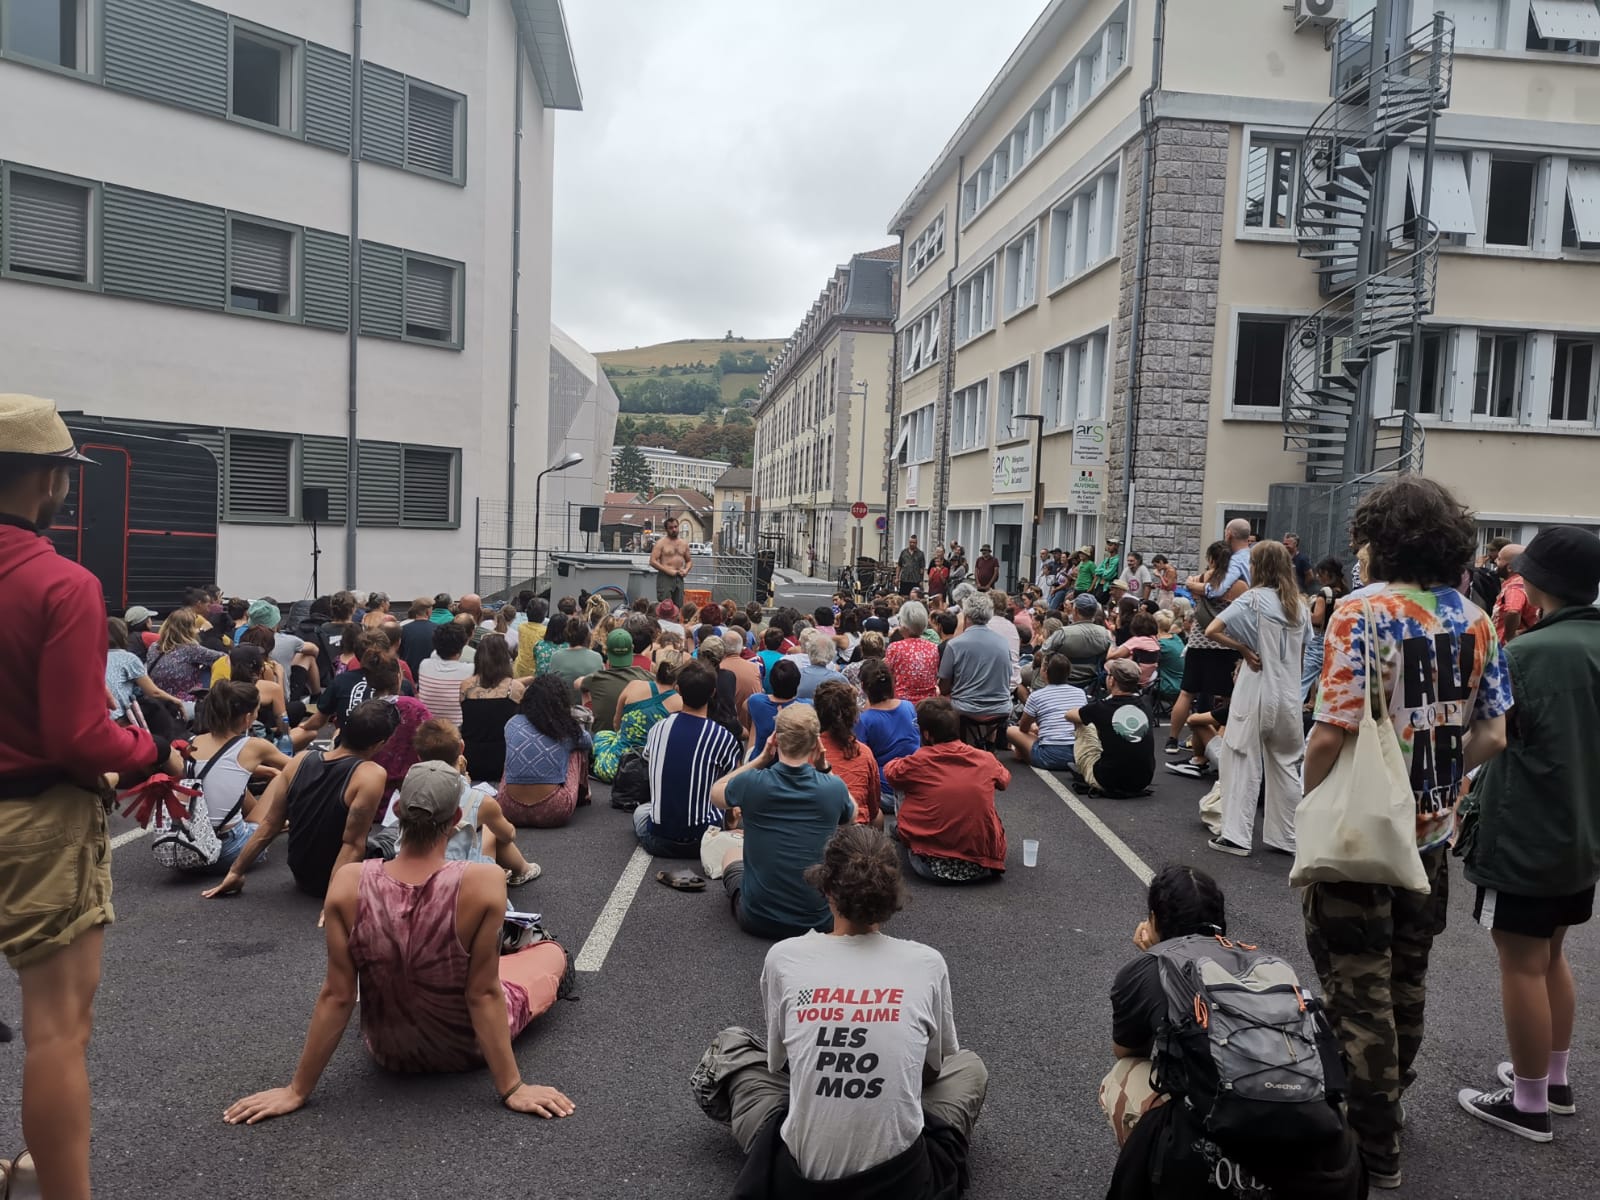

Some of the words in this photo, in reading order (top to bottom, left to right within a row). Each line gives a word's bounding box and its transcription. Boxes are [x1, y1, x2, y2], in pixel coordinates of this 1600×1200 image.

[1076, 425, 1104, 443] ars
[995, 455, 1011, 486] ars
[812, 988, 904, 1004] RALLYE
[797, 1008, 844, 1023] VOUS
[851, 1008, 900, 1022] AIME
[816, 1026, 868, 1048] LES
[816, 1051, 879, 1074] PRO
[815, 1077, 885, 1099] MOS
